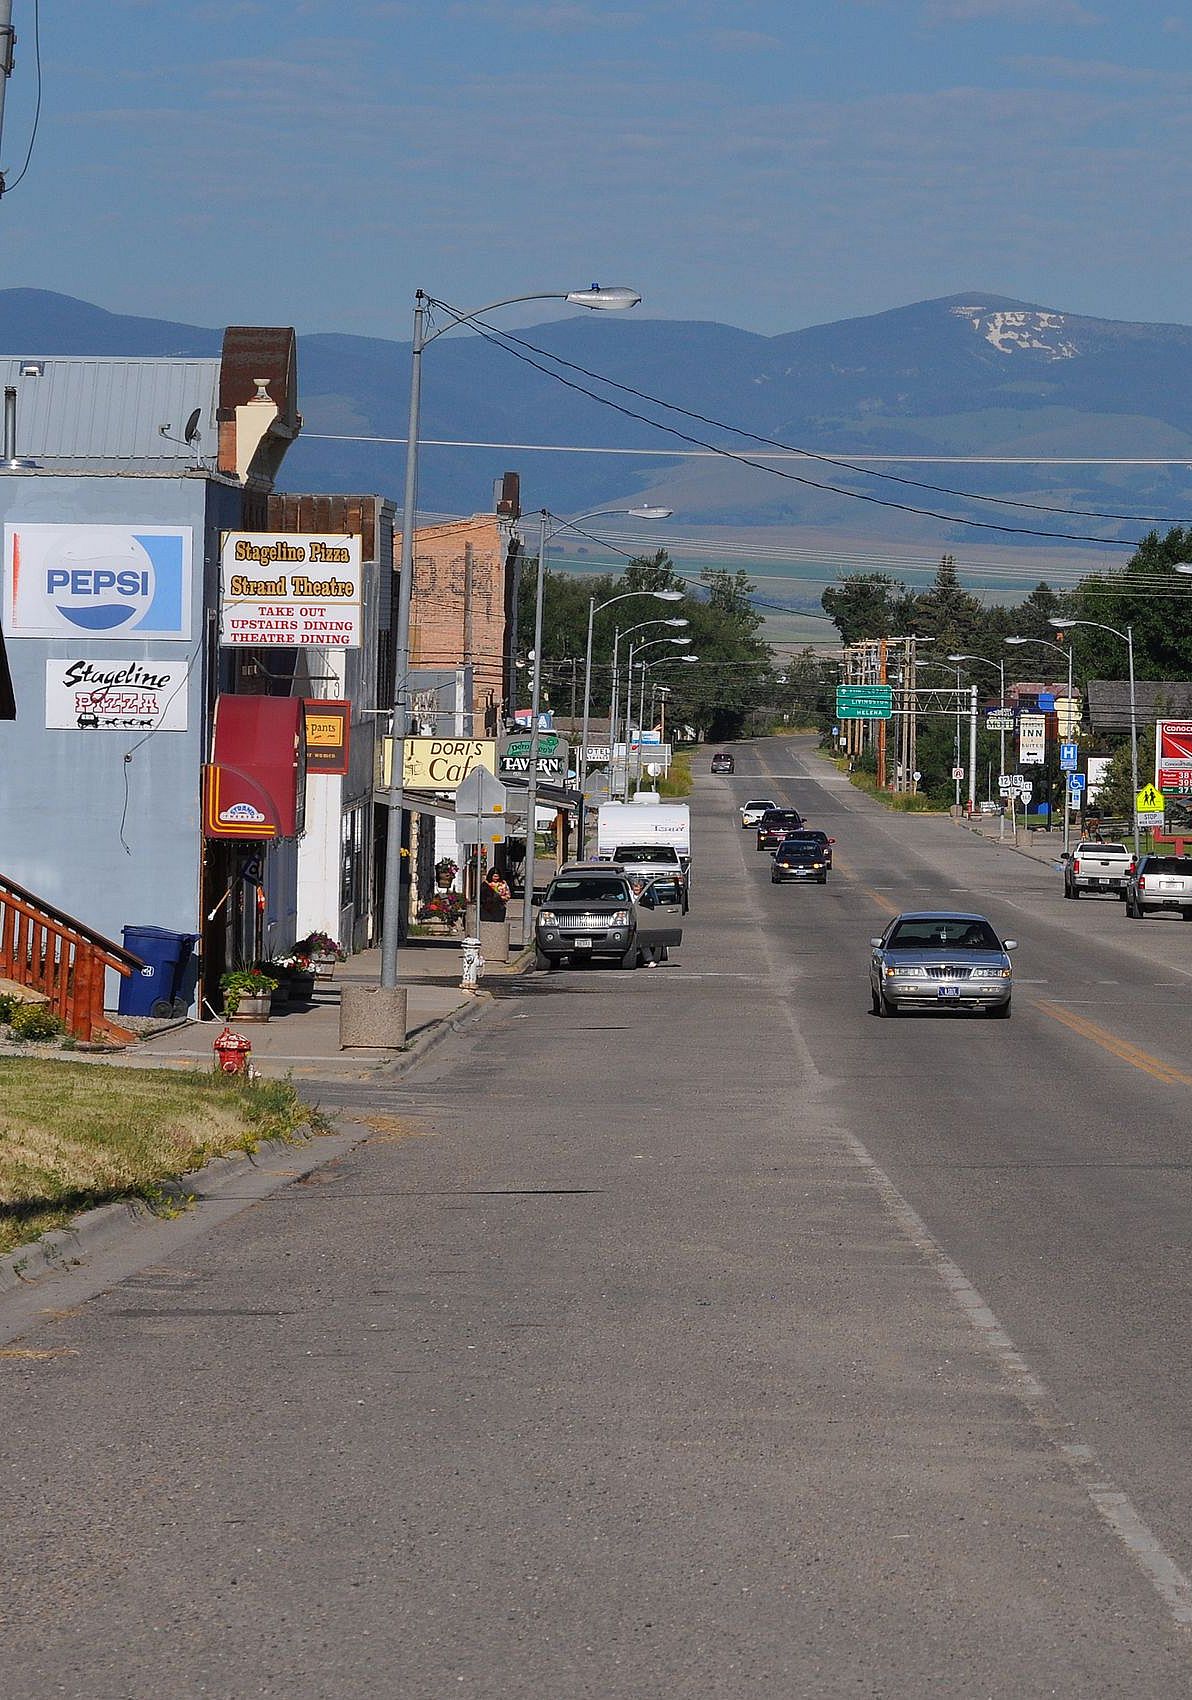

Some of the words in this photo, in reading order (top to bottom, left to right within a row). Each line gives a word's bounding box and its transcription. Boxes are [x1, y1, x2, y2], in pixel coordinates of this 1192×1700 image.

[235, 541, 305, 566] Stageline
[309, 542, 350, 563] Pizza
[47, 569, 149, 596] PEPSI
[231, 575, 287, 596] Strand
[291, 576, 354, 597] Theatre
[258, 607, 294, 616] TAKE
[300, 607, 326, 617] OUT
[231, 619, 298, 630] UPSTAIRS
[304, 621, 353, 631] DINING
[231, 633, 294, 643] THEATRE
[300, 634, 350, 644] DINING
[63, 660, 171, 694] Stageline
[75, 692, 159, 714] PIZZA
[311, 723, 336, 735] pants
[1023, 729, 1043, 737] INN
[430, 742, 484, 756] DORI'S
[1064, 747, 1074, 758] H
